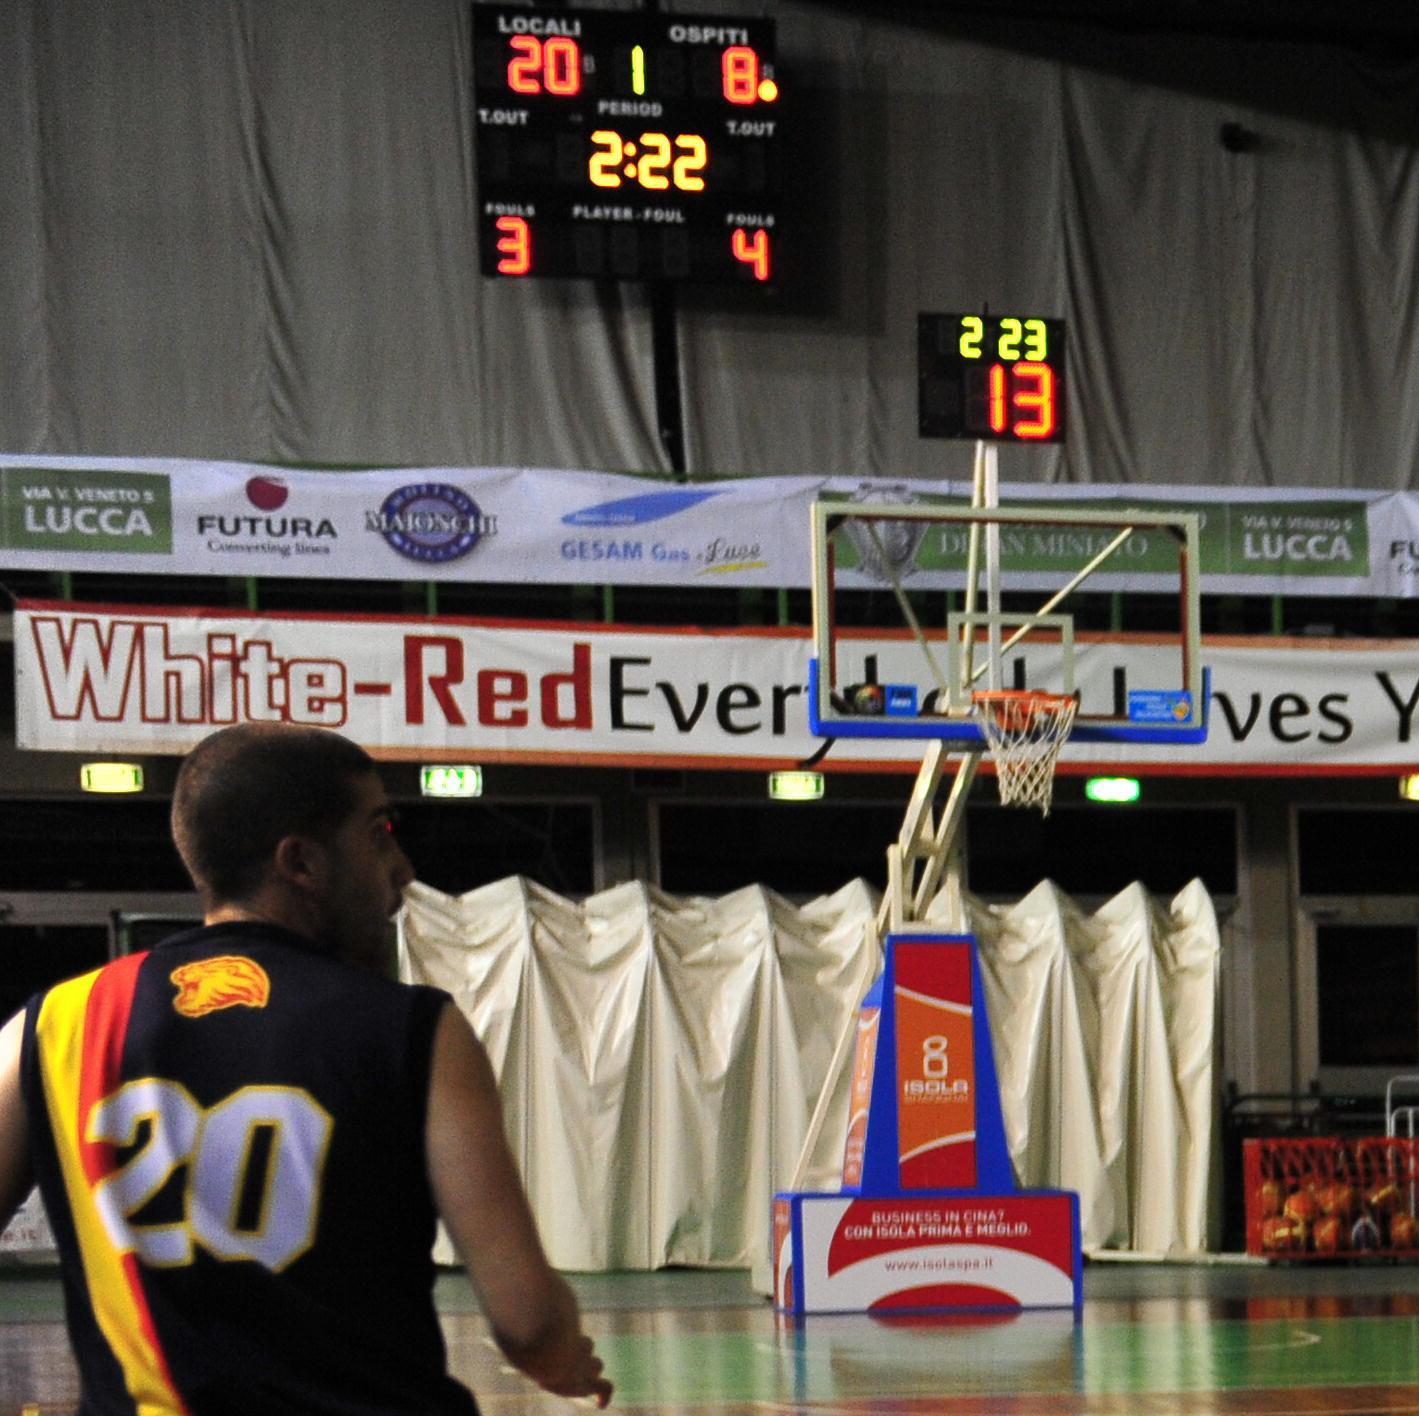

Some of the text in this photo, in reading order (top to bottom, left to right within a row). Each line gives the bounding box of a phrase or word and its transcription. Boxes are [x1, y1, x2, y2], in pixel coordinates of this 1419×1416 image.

[499, 16, 581, 36] LOCALI
[669, 25, 748, 45] OSPITI
[507, 35, 580, 94] 20
[631, 45, 645, 96] 1
[478, 109, 529, 125] T.OUT
[597, 100, 662, 117] PERIOD
[726, 120, 776, 136] T.OUT
[588, 130, 707, 191] 2:22
[484, 202, 535, 217] FOULS
[727, 213, 774, 227] FOULS
[495, 216, 531, 276] 3
[731, 228, 769, 281] 4
[988, 361, 1055, 439] 13
[23, 486, 52, 499] VIA
[25, 504, 153, 537] LUCCA
[197, 515, 338, 539] FUTURA
[561, 540, 643, 561] GESAM
[651, 542, 690, 562] Gas
[1244, 532, 1353, 562] LUCCA
[30, 615, 592, 730] White-Red
[904, 1079, 968, 1096] ISOLA
[86, 1077, 335, 1274] 20
[872, 1208, 1005, 1224] BUSINESS IN CINA?
[844, 1225, 874, 1240] CON
[876, 1224, 917, 1239] ISOLA
[919, 1224, 963, 1238] PRIMA
[885, 1255, 994, 1272] www.isolaspa.it
